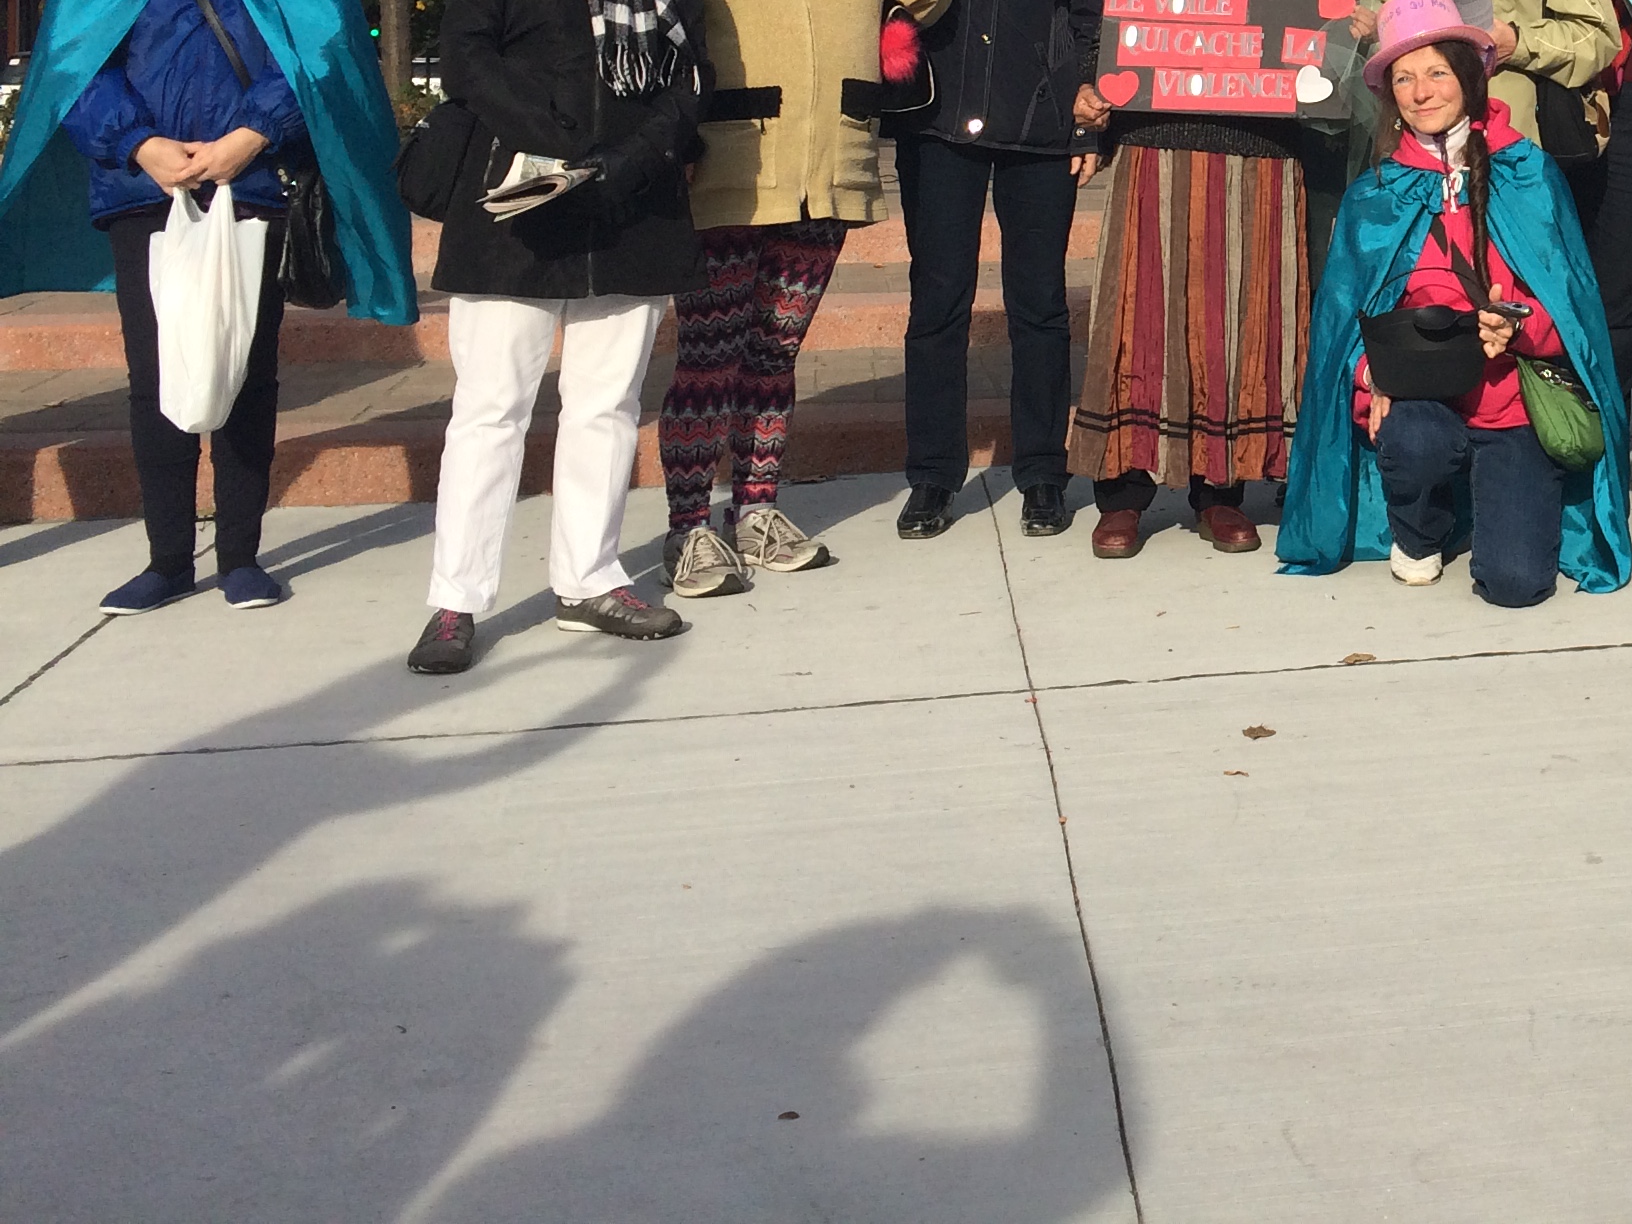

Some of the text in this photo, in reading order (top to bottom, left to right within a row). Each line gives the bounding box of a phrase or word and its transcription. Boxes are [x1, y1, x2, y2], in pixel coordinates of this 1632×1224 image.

[1122, 25, 1324, 61] QUI CACHE LA
[1156, 70, 1294, 99] VIOLENCE
